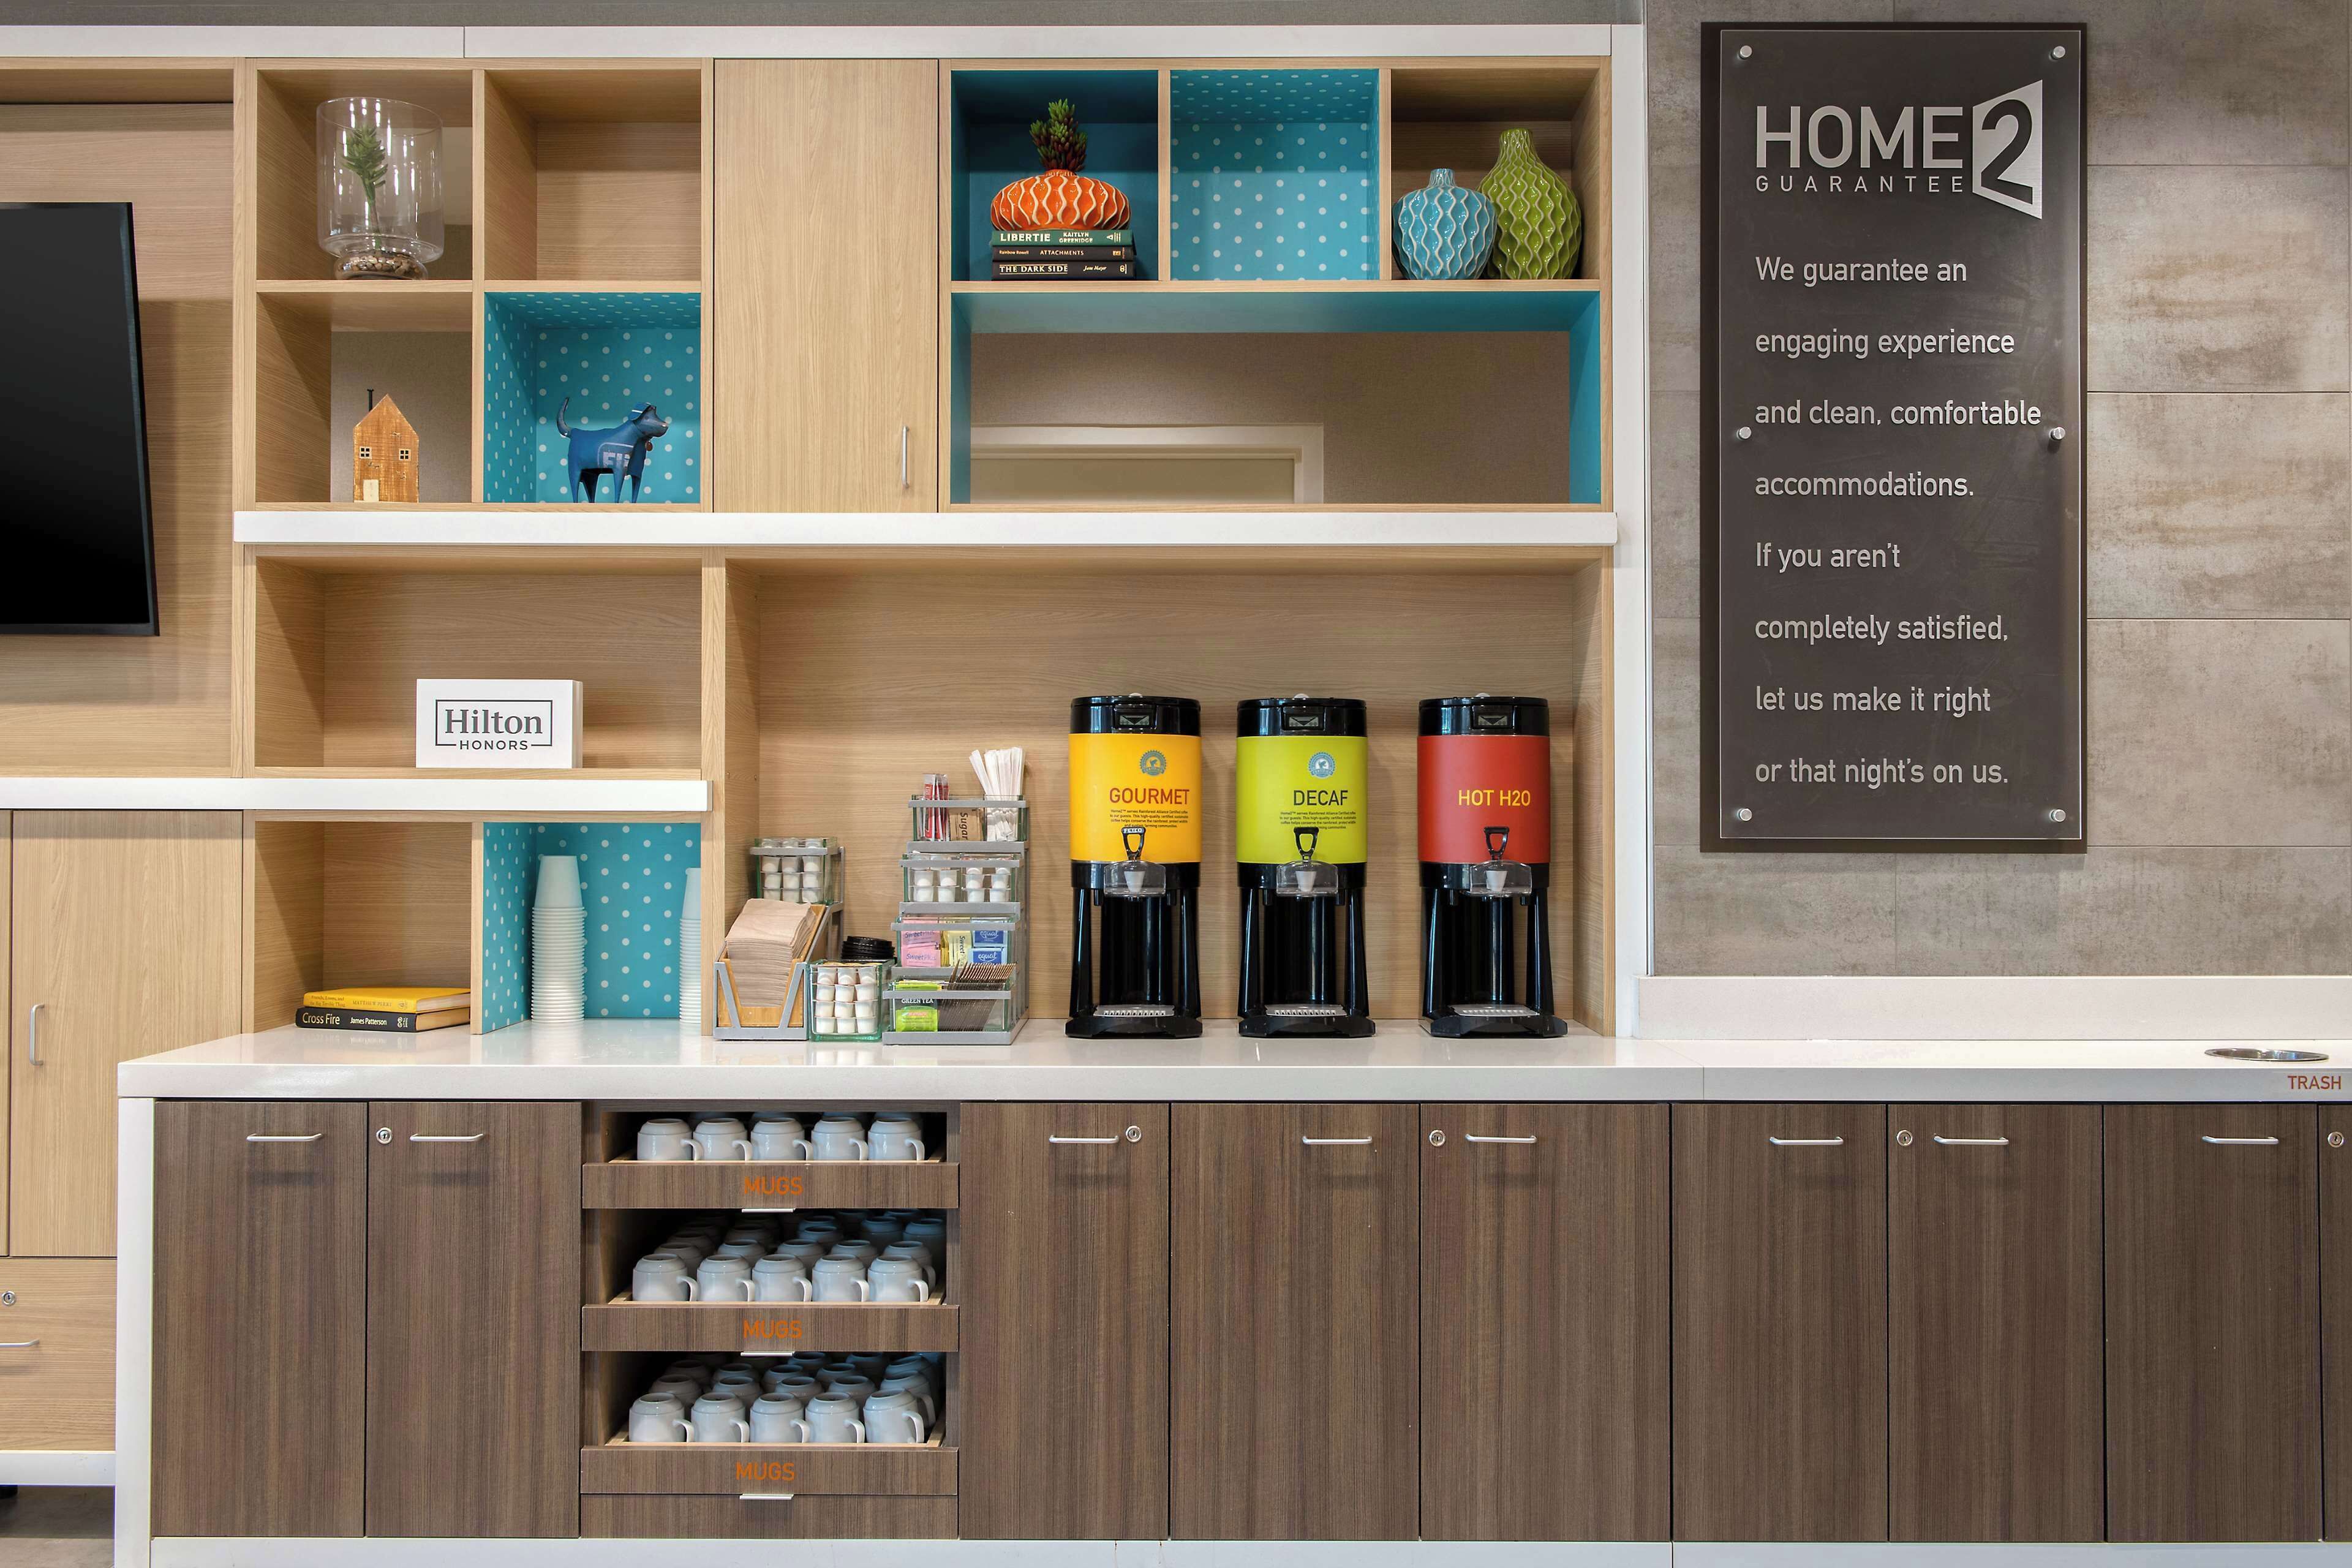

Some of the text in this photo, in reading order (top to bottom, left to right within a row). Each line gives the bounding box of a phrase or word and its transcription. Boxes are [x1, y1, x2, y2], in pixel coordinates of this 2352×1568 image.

[1756, 175, 1963, 192] GUARANTEE
[1000, 233, 1051, 242] LIBERTIE
[1755, 257, 1967, 287] We guarantee an
[1755, 328, 2015, 359] engaging experience
[1755, 399, 2041, 426] and clean, comfortable
[1755, 471, 1973, 496] accommodations.
[1757, 542, 1900, 573] If you aren't
[1755, 614, 2008, 646] completely satisfied,
[1757, 685, 1991, 718] let us make it right
[445, 709, 543, 734] Hilton
[459, 740, 528, 750] HONORS
[1755, 757, 2008, 790] or that night's on us.
[1109, 788, 1189, 805] GOURMET
[1293, 790, 1348, 806] DECAF
[1458, 790, 1494, 806] HOT
[959, 812, 968, 840] Sugar
[980, 930, 999, 939] equal
[978, 951, 998, 961] equal
[303, 1012, 324, 1023] Cross
[325, 1013, 341, 1025] Fire
[2288, 1076, 2342, 1090] TRASH
[744, 1176, 804, 1195] MUGS
[743, 1320, 803, 1338] MUGS
[736, 1462, 796, 1481] MUGS
